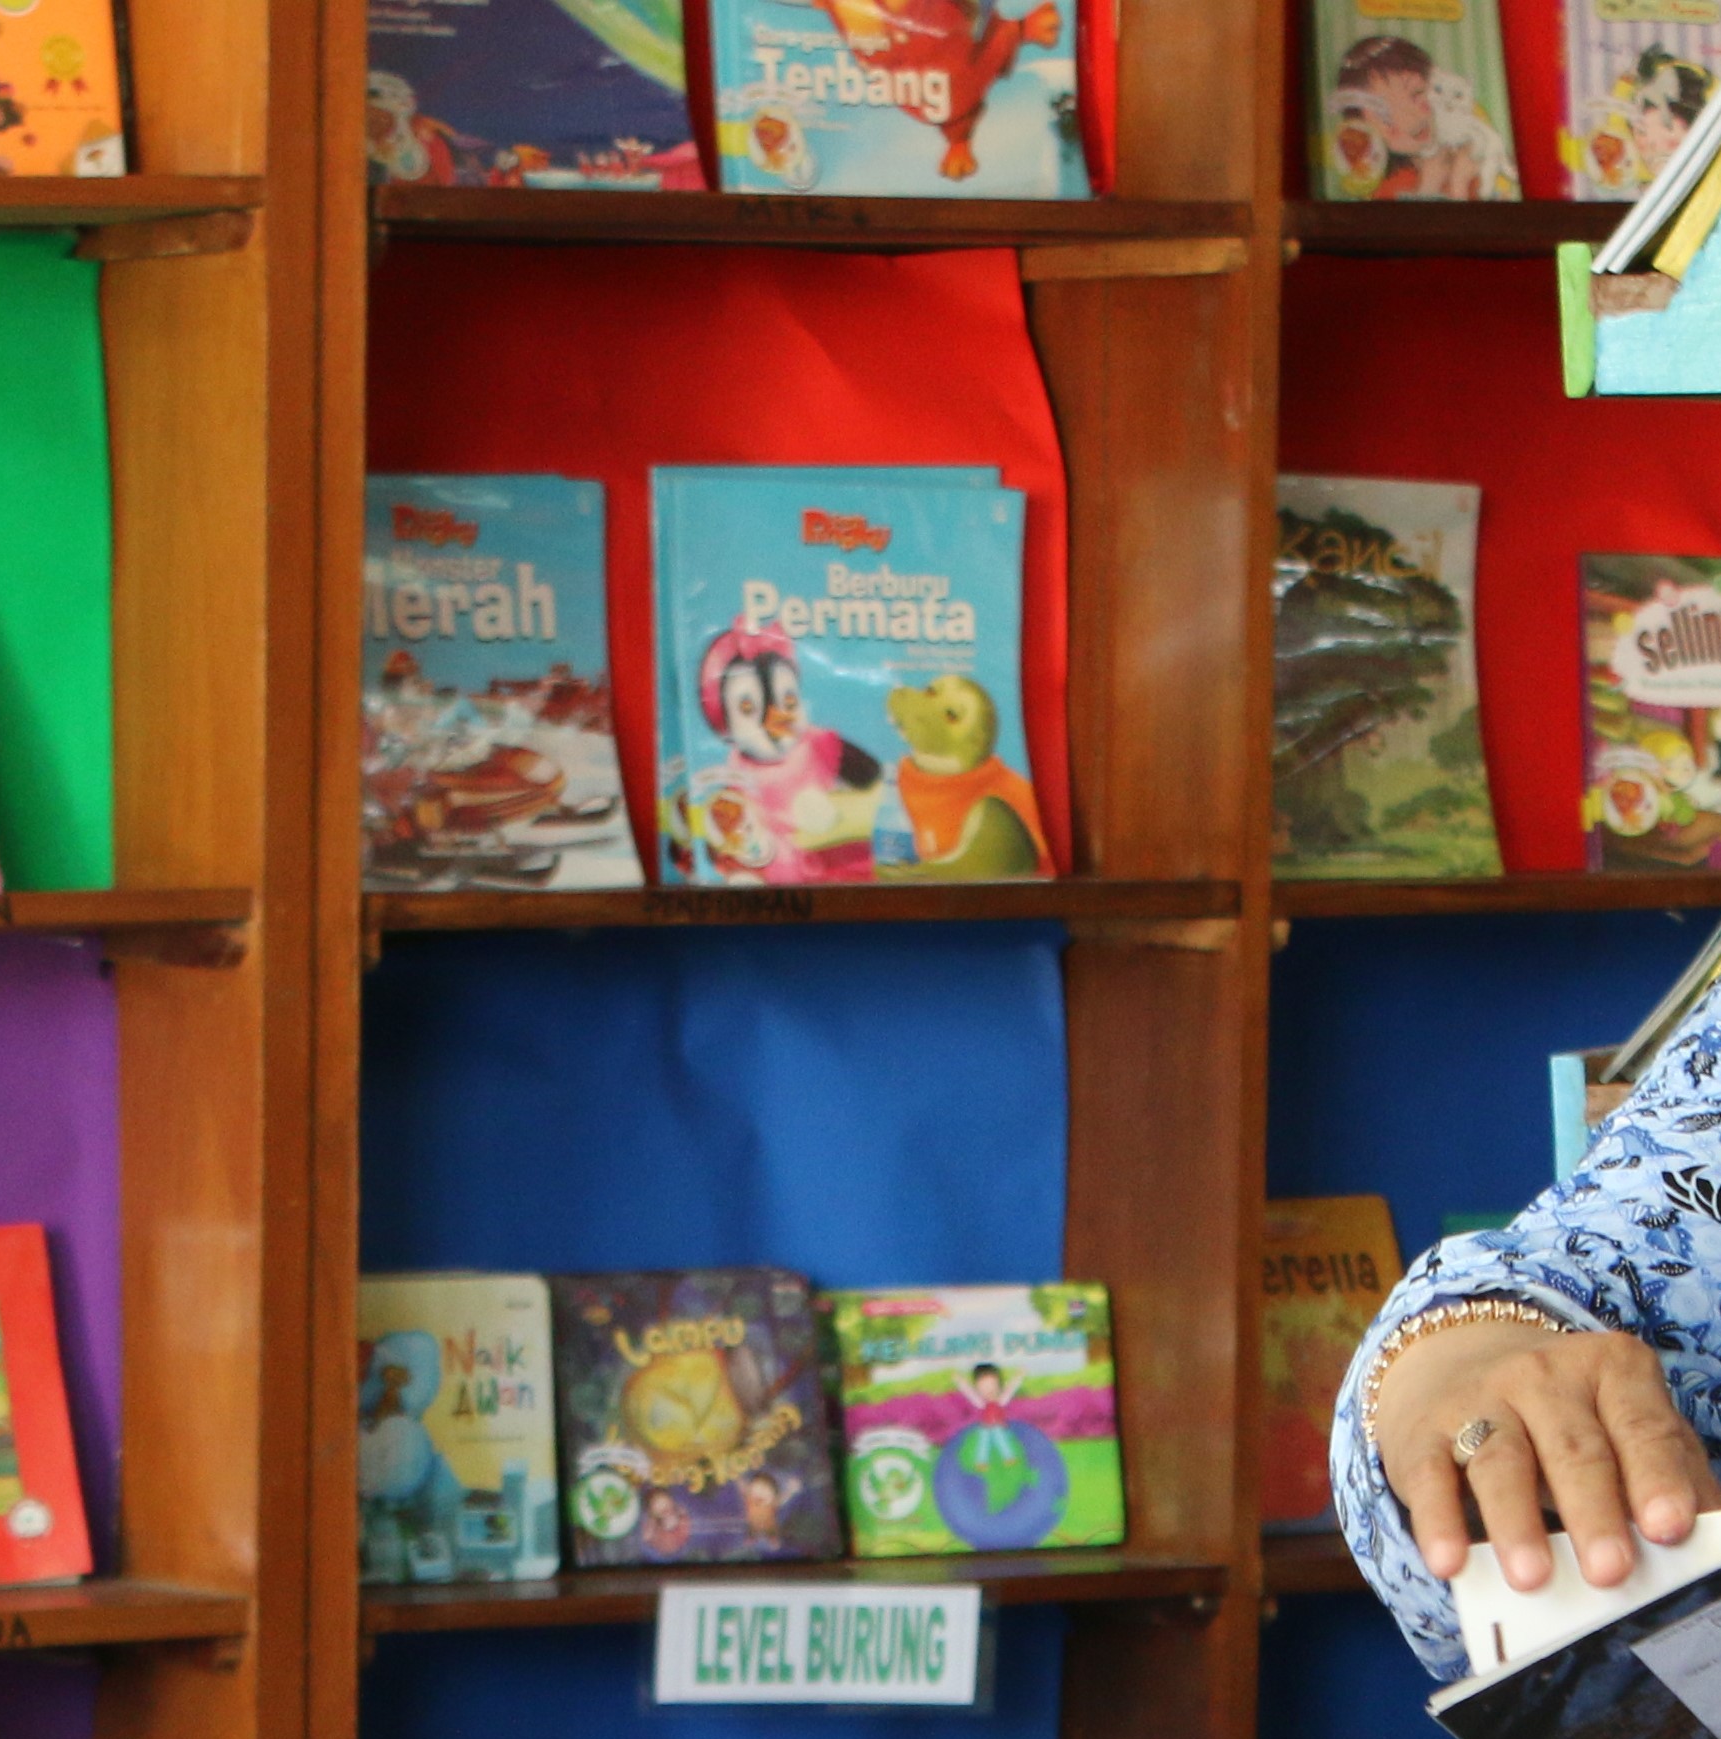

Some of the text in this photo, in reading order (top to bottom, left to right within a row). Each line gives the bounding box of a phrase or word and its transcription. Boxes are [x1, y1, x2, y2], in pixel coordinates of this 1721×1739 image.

[752, 48, 951, 124] Terbang
[742, 579, 976, 645] Permata
[826, 562, 950, 600] Berburu
[442, 1328, 528, 1375] Naik
[695, 1604, 947, 1684] LEVEL BURUNG
